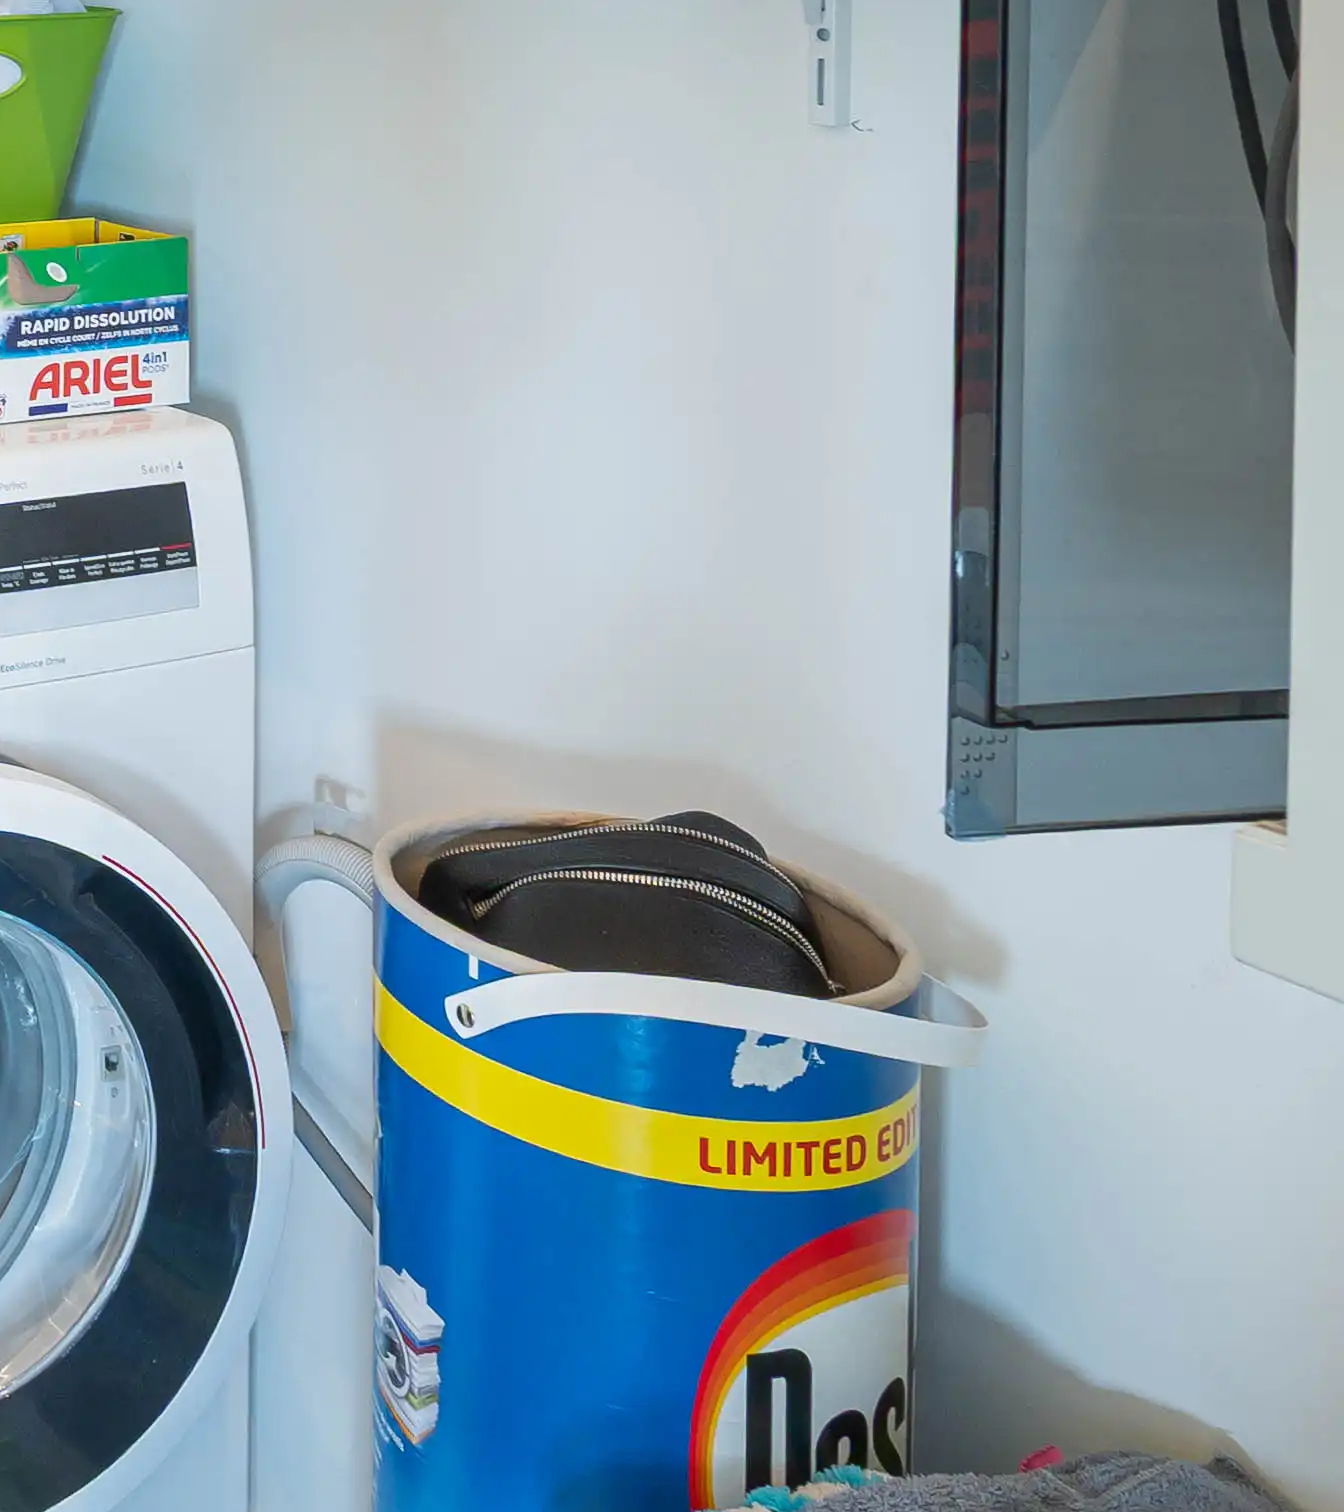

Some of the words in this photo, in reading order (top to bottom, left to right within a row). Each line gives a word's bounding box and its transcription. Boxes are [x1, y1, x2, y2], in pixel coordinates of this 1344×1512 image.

[20, 317, 70, 335] RAPID
[74, 307, 176, 330] DISSOLUTION
[142, 352, 167, 364] 4in1
[29, 354, 153, 402] ARIEL
[698, 1136, 867, 1177] LIMITED
